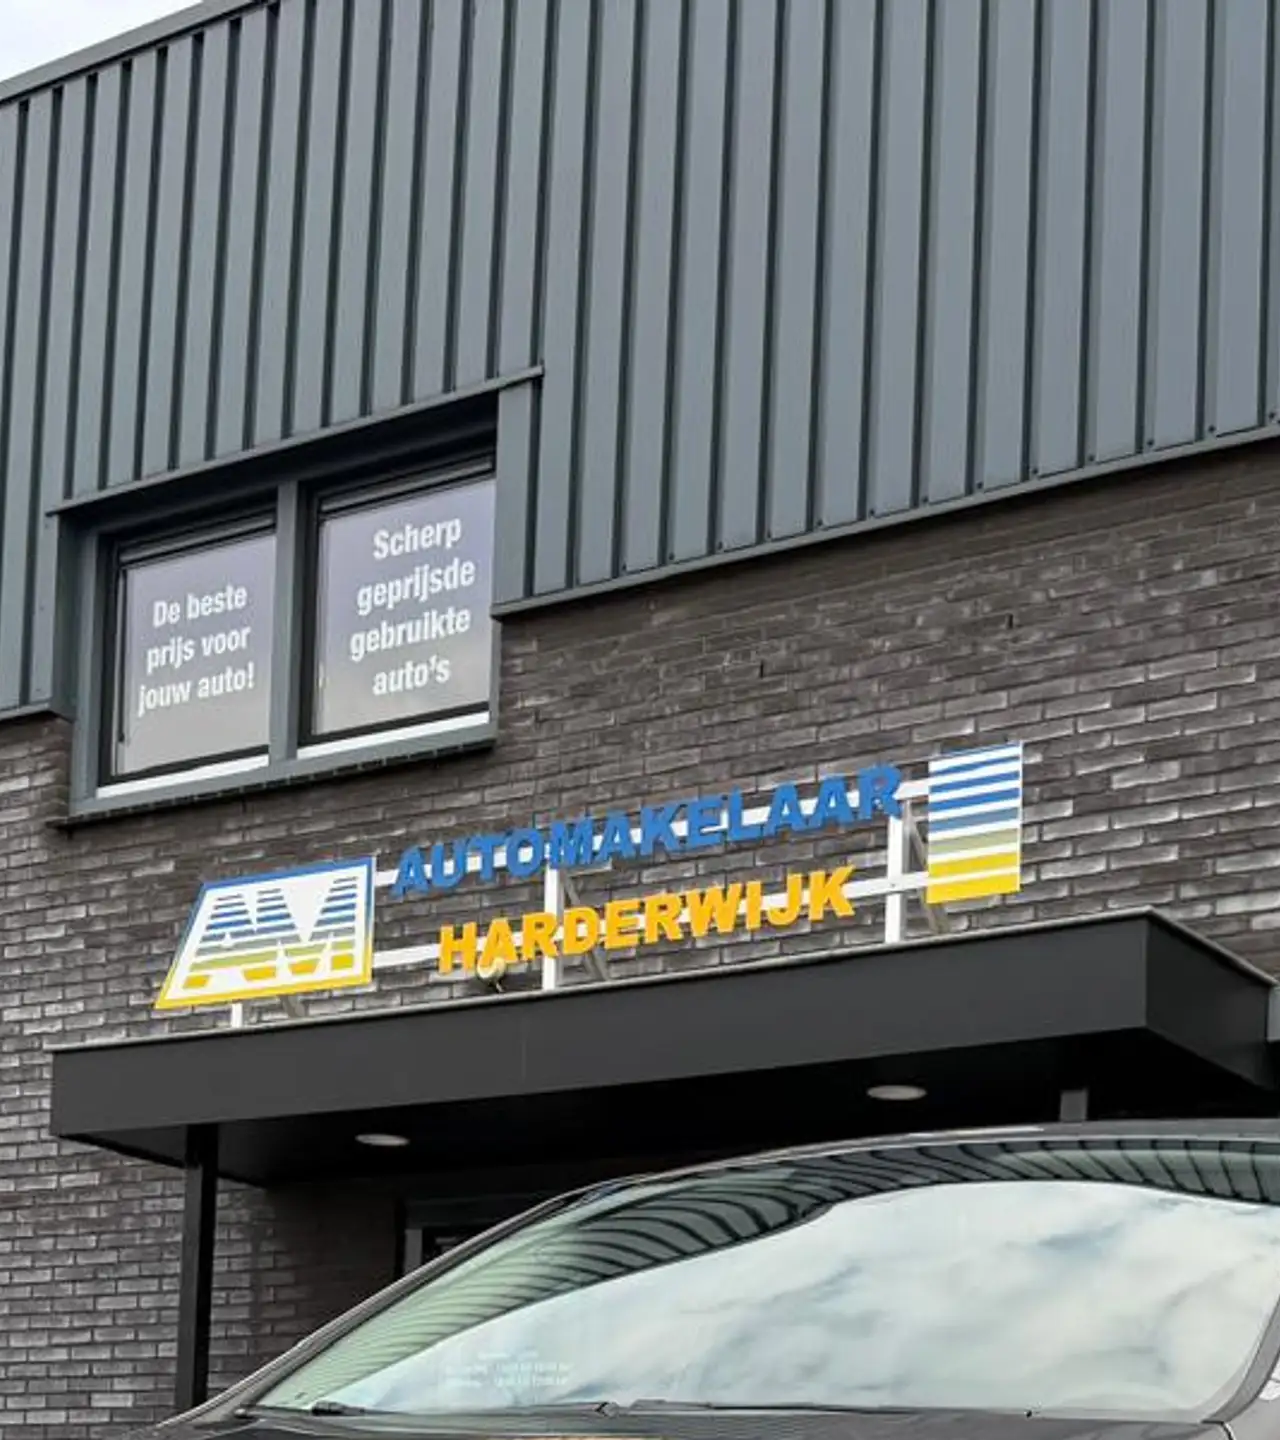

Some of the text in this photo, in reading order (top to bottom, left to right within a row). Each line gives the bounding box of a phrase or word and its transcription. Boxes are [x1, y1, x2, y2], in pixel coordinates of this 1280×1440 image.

[373, 518, 461, 560] Scherp
[152, 584, 247, 628] De beste
[356, 557, 476, 616] geprijsde
[146, 625, 251, 676] prijs voor
[350, 605, 471, 661] gebruikte
[137, 661, 254, 718] jouw auto!
[372, 654, 451, 696] auto's
[392, 763, 903, 896] AUTOMAKELAAR
[439, 863, 855, 974] HARDERWIJK
